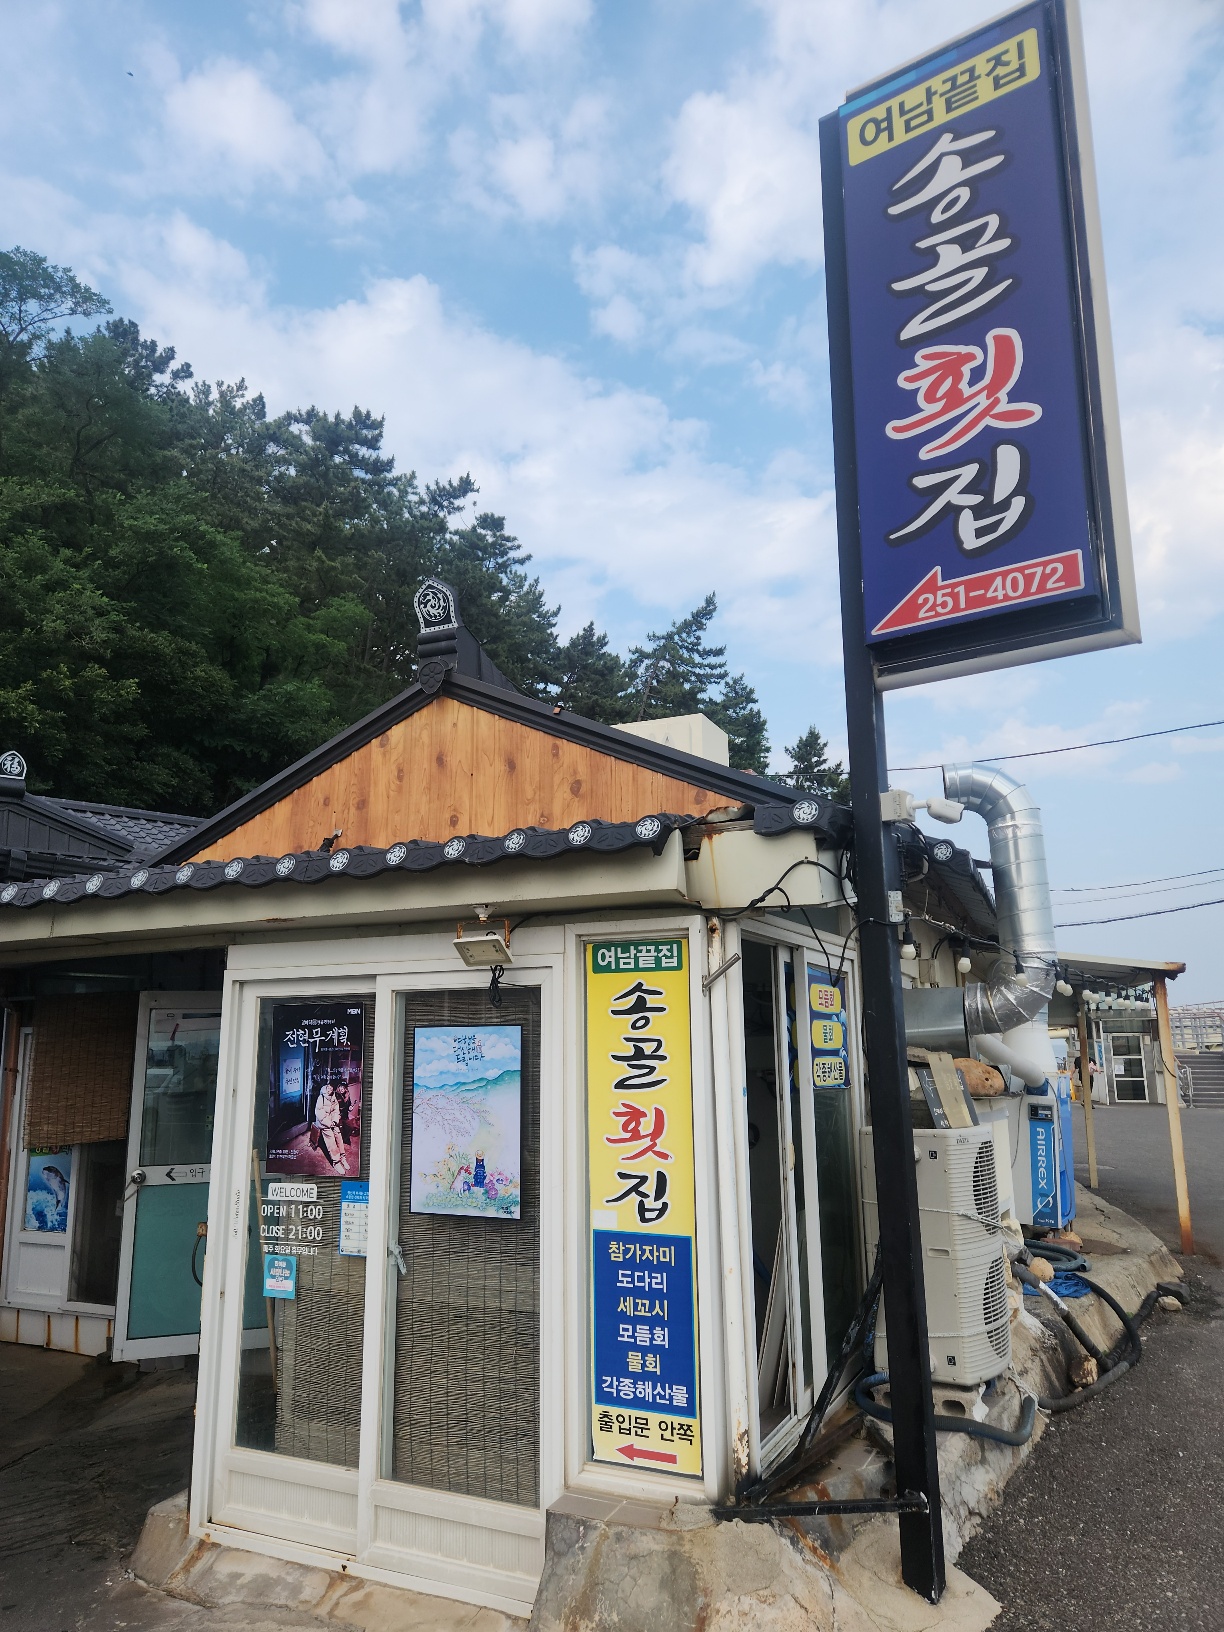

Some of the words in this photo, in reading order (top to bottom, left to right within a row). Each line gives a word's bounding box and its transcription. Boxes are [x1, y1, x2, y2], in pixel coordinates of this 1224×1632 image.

[859, 39, 1028, 146] 여남끝집
[886, 130, 1043, 550] 송골횟집
[918, 562, 1065, 619] 251-4072
[597, 943, 678, 970] 여남끝집
[605, 981, 673, 1224] 송골횟집
[1036, 1127, 1048, 1190] AIRREX
[189, 1167, 206, 1178] 입구
[270, 1186, 315, 1199] WELCOME
[261, 1204, 286, 1217] OPEN
[289, 1204, 323, 1219] 11:00
[260, 1225, 286, 1238] CLOSE
[288, 1225, 323, 1241] 21:00
[608, 1241, 676, 1267] 참가자미
[616, 1269, 667, 1293] 도다리
[617, 1296, 668, 1320] 세꼬시
[617, 1323, 669, 1349] 모듬회
[626, 1351, 661, 1375] 물회
[601, 1376, 689, 1407] 각종해산물
[597, 1410, 650, 1438] 출입문
[658, 1420, 695, 1446] 안쪽
